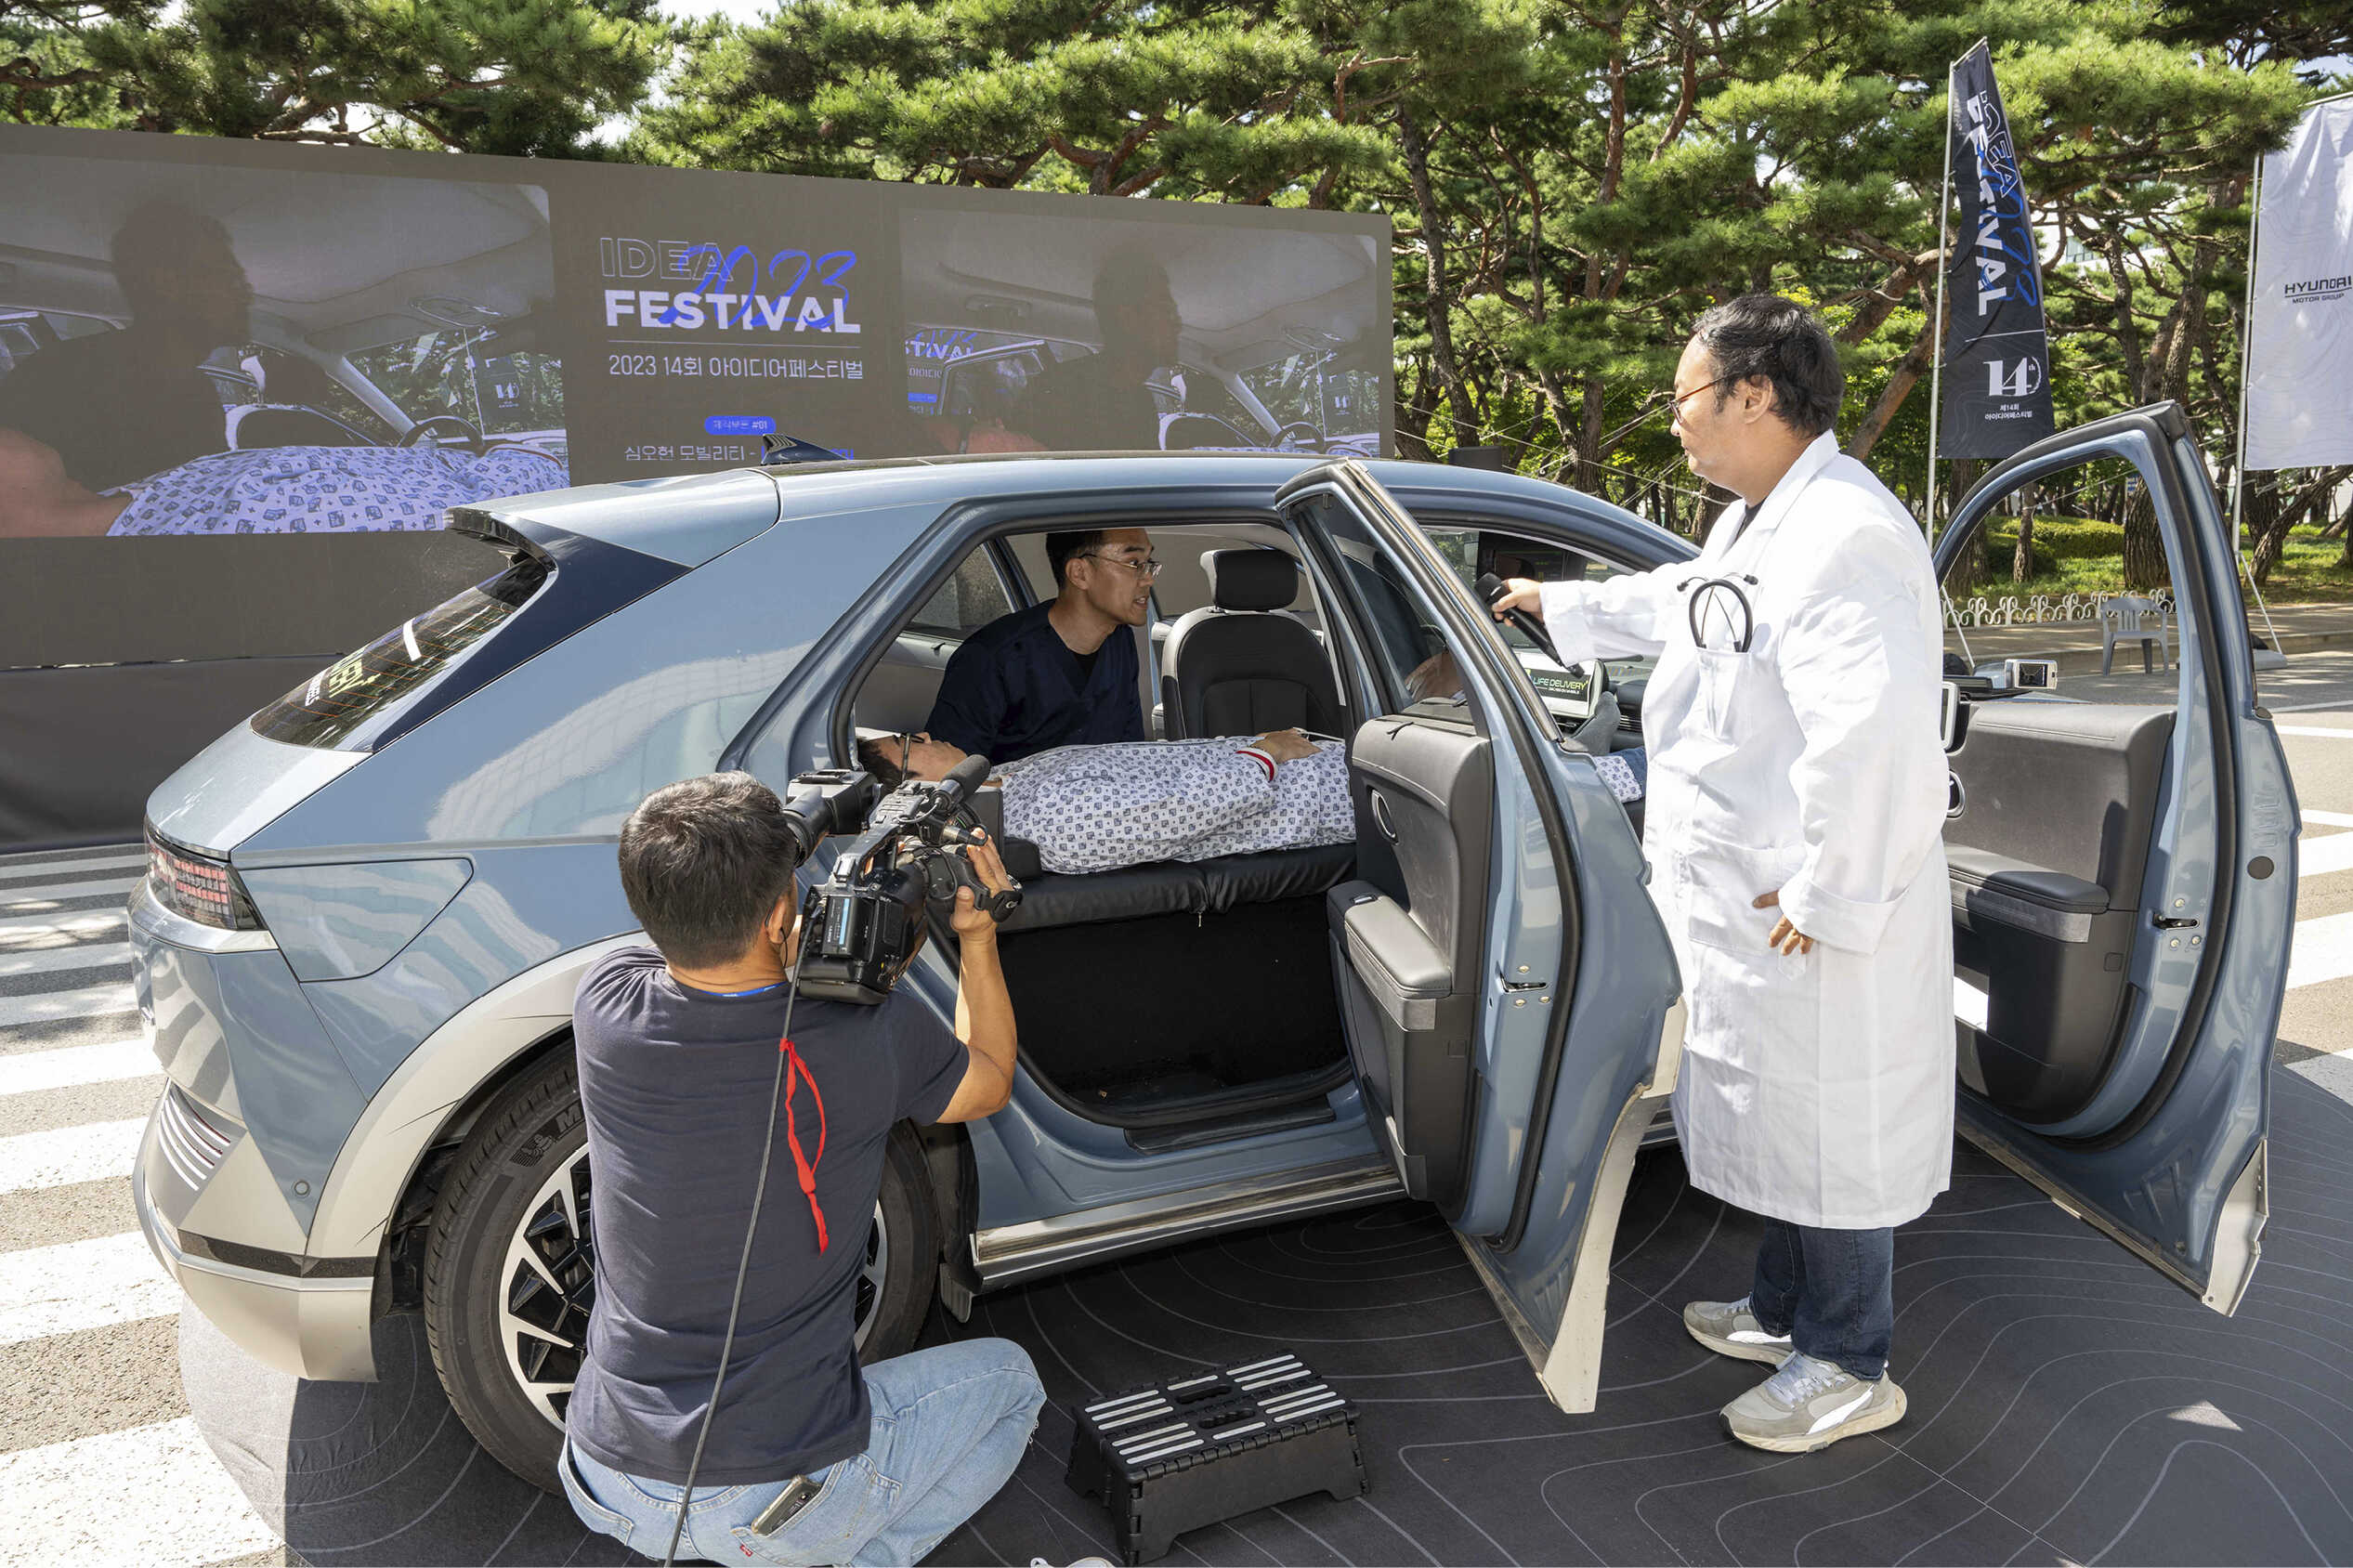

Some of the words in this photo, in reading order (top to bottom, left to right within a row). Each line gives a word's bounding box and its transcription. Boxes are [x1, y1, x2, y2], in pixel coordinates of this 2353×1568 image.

[600, 238, 734, 281] IDEA
[2285, 276, 2352, 294] HYUNDAI
[2321, 293, 2345, 301] GROUP
[605, 289, 861, 333] FESTIVAL
[608, 355, 657, 375] 2023
[663, 356, 702, 376] 14회
[709, 357, 863, 379] 아이디어페스티벌
[680, 446, 744, 462] 모빌리티
[1533, 677, 1549, 686] LIFE
[1549, 679, 1588, 691] DELIVERY
